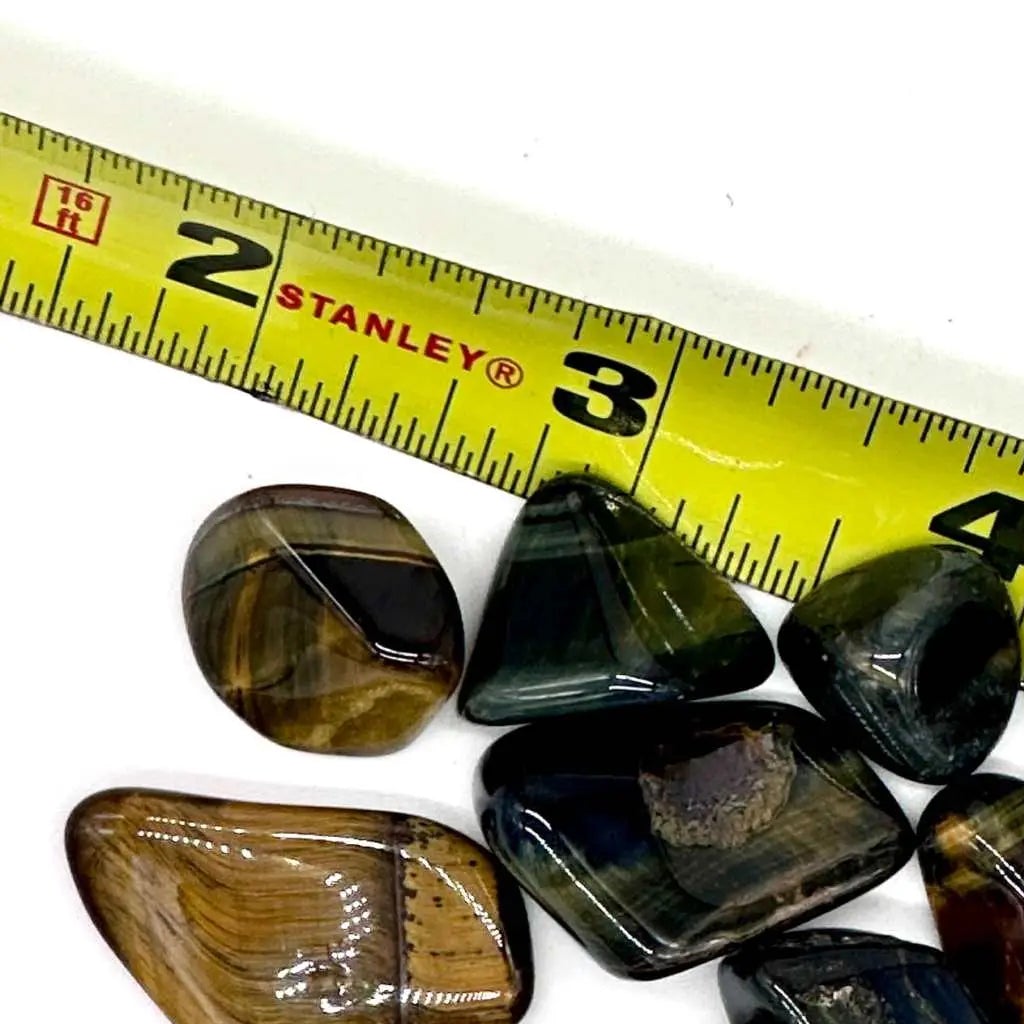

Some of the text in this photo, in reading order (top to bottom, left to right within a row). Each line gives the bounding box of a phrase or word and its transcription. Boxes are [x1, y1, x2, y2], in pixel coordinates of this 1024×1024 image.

[56, 183, 94, 212] 16
[56, 206, 83, 238] ft
[165, 221, 274, 308] 2
[551, 350, 658, 437] 3
